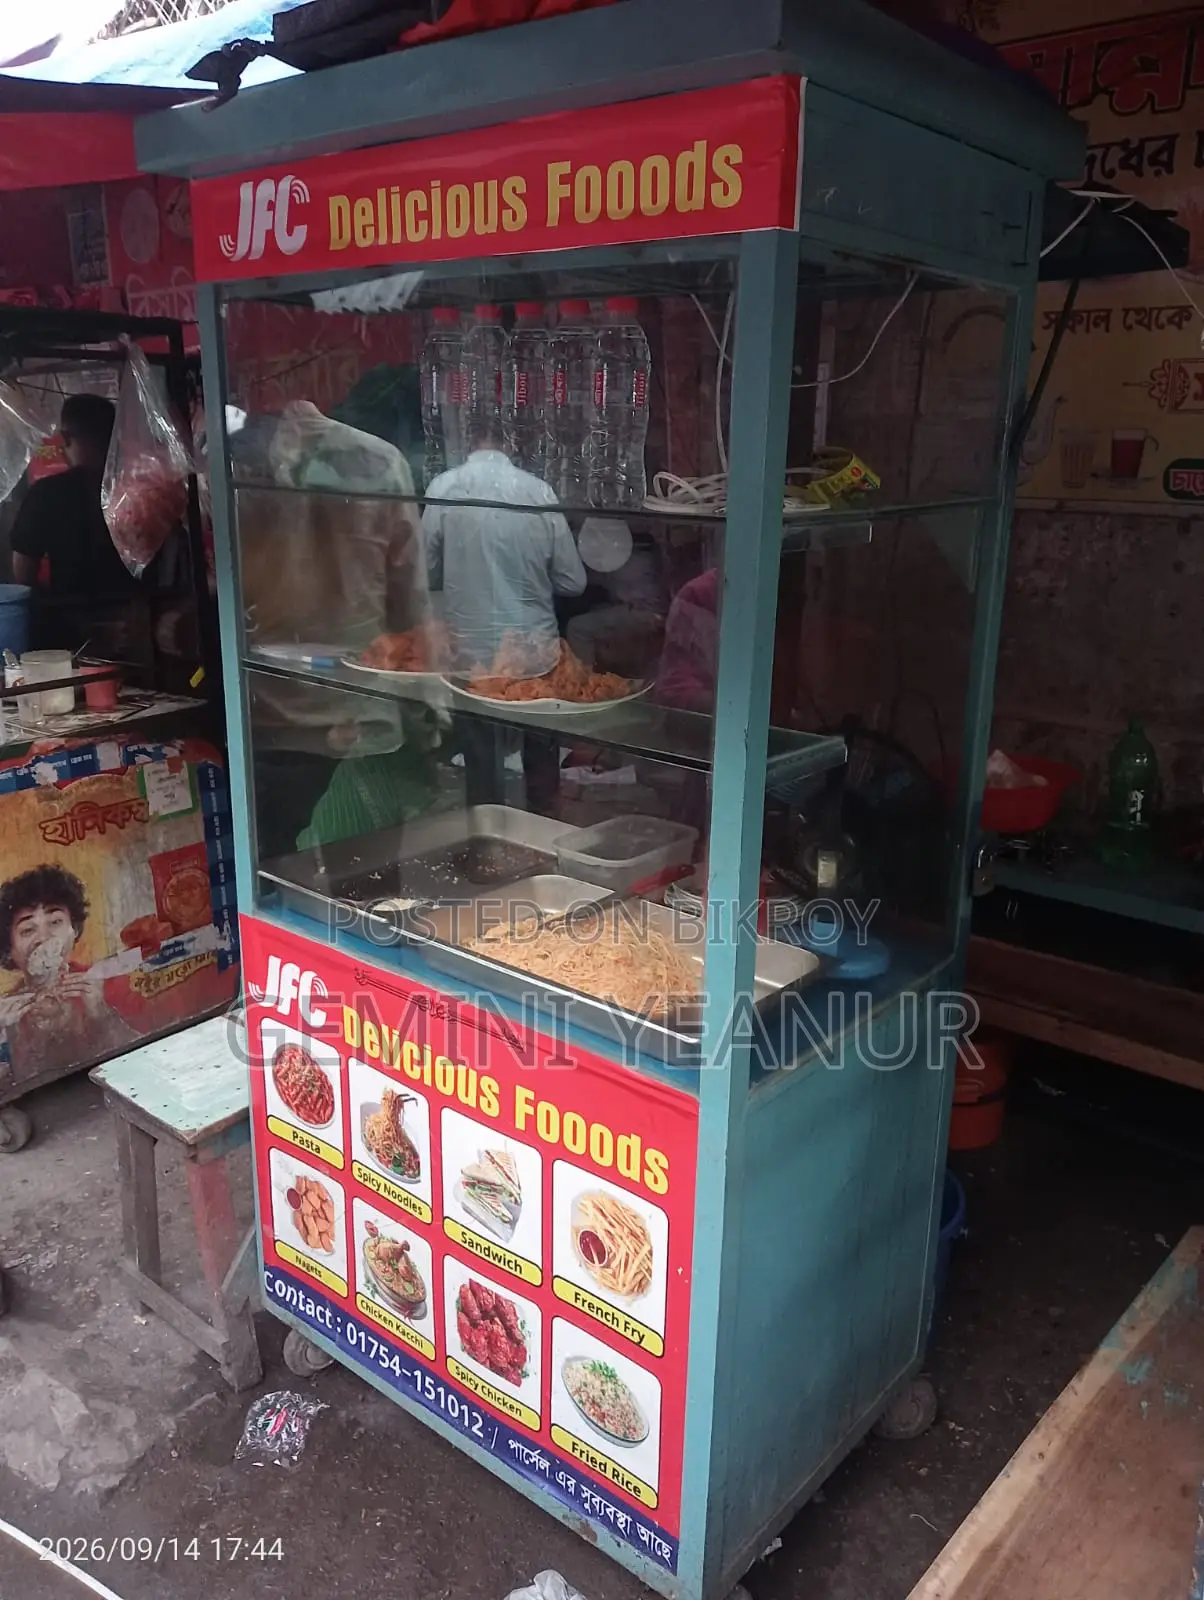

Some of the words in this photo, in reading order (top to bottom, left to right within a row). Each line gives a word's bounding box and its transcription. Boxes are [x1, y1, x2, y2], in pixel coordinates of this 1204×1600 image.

[219, 175, 310, 261] JFC
[329, 176, 527, 250] Delicious
[546, 140, 743, 226] Fooods
[1122, 304, 1195, 332] থেকে
[248, 955, 328, 1028] JFC
[343, 1005, 500, 1118] Delicious
[515, 1085, 669, 1195] Fooods
[292, 1130, 321, 1154] Pasta
[357, 1167, 383, 1192] Spicy
[384, 1183, 423, 1216] Noodles
[295, 1255, 322, 1278] Nagets
[461, 1231, 523, 1275] Sandwich
[360, 1299, 394, 1328] Chicken
[395, 1323, 424, 1349] Kacchi
[574, 1292, 620, 1327] French
[623, 1320, 646, 1346] Fry
[455, 1365, 480, 1391] Spicy
[481, 1385, 522, 1417] Chicken
[346, 1322, 484, 1438] 01754-151012
[508, 1439, 551, 1478] পার্সেল
[555, 1471, 576, 1497] এর
[636, 1522, 673, 1567] আছে
[572, 1441, 608, 1474] Fried
[612, 1467, 642, 1498] Rice
